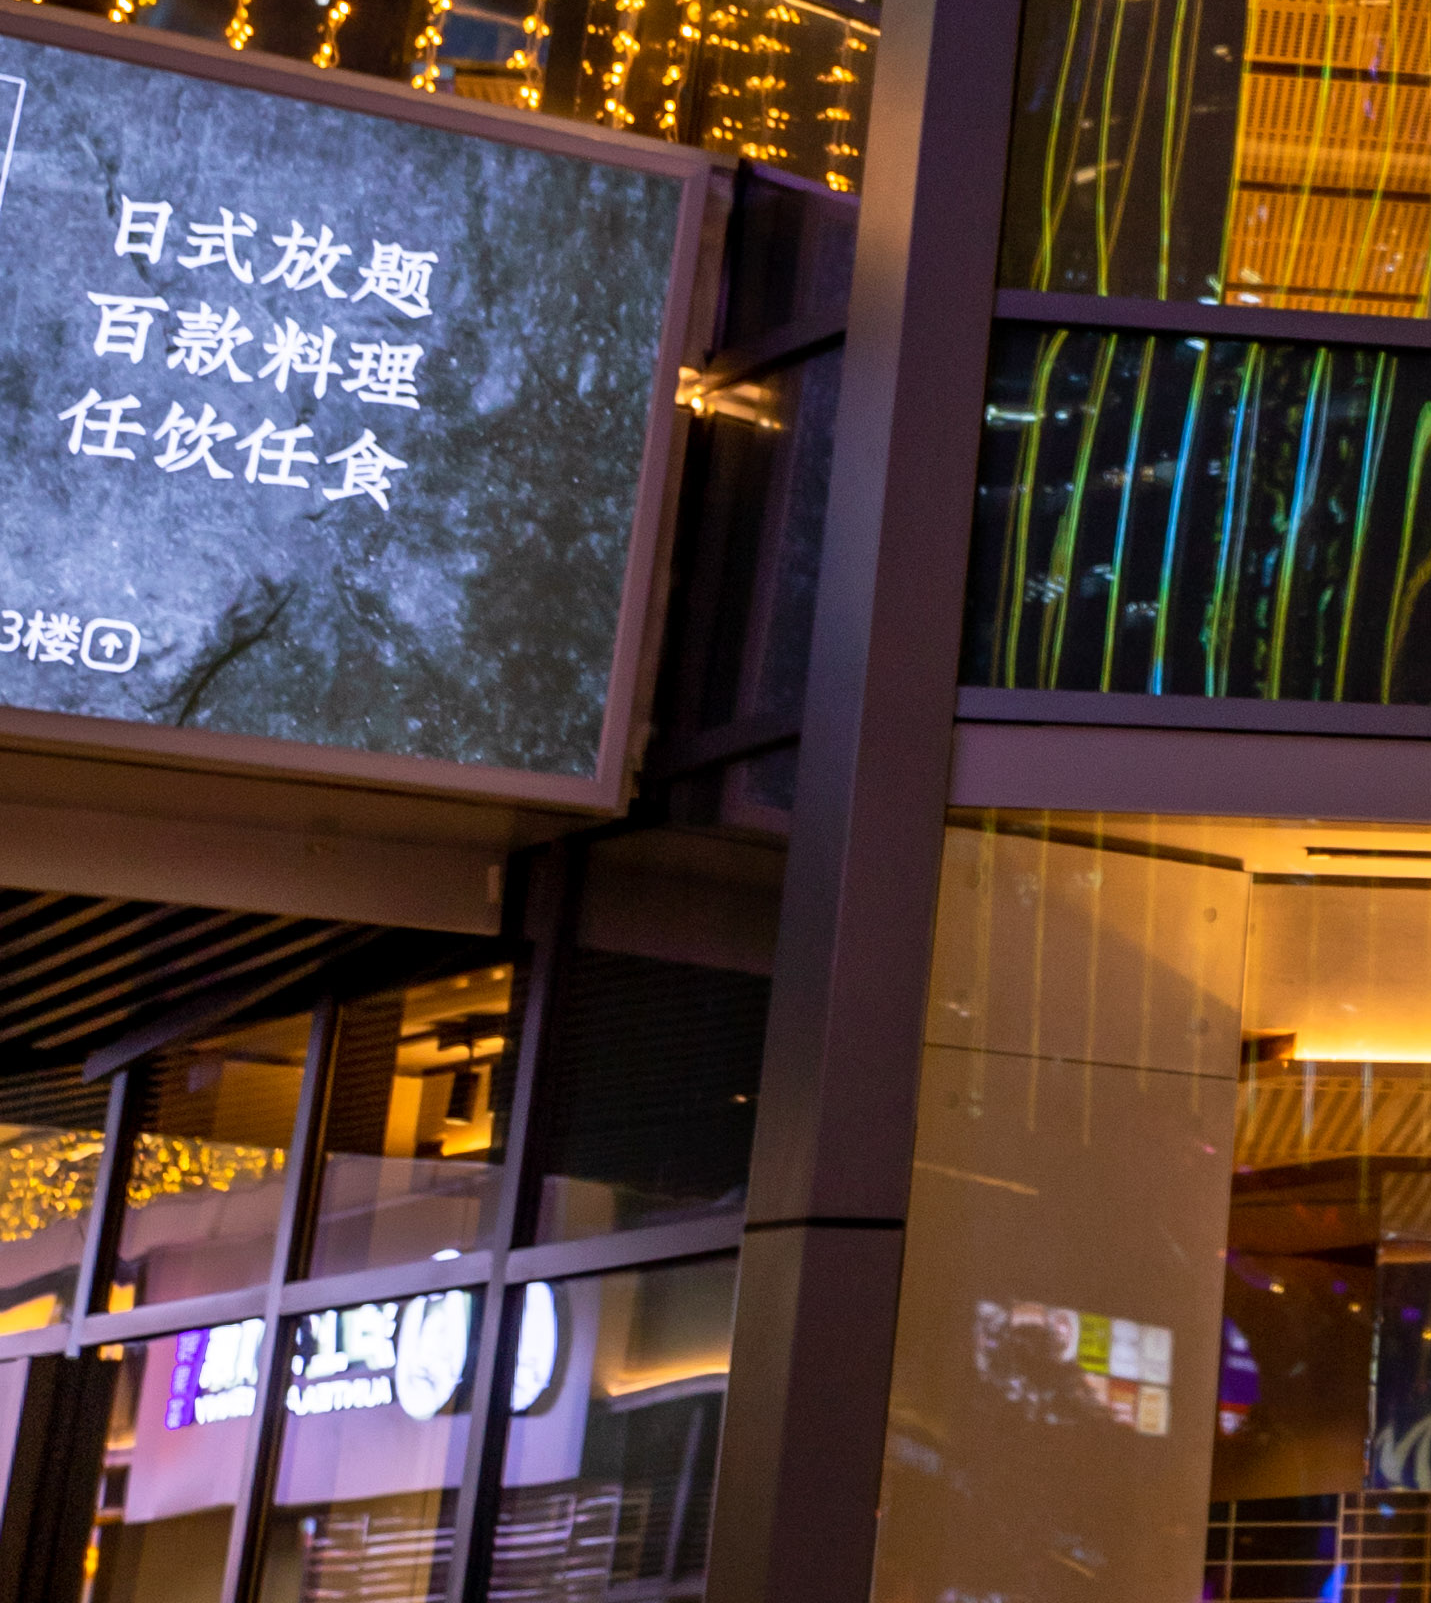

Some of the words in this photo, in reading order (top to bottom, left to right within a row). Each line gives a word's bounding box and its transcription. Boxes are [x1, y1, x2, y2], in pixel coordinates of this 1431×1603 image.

[114, 195, 439, 319] 日式放题
[87, 292, 425, 410] 百款料理
[57, 388, 408, 512] 任饮任食
[0, 609, 82, 665] 3楼
